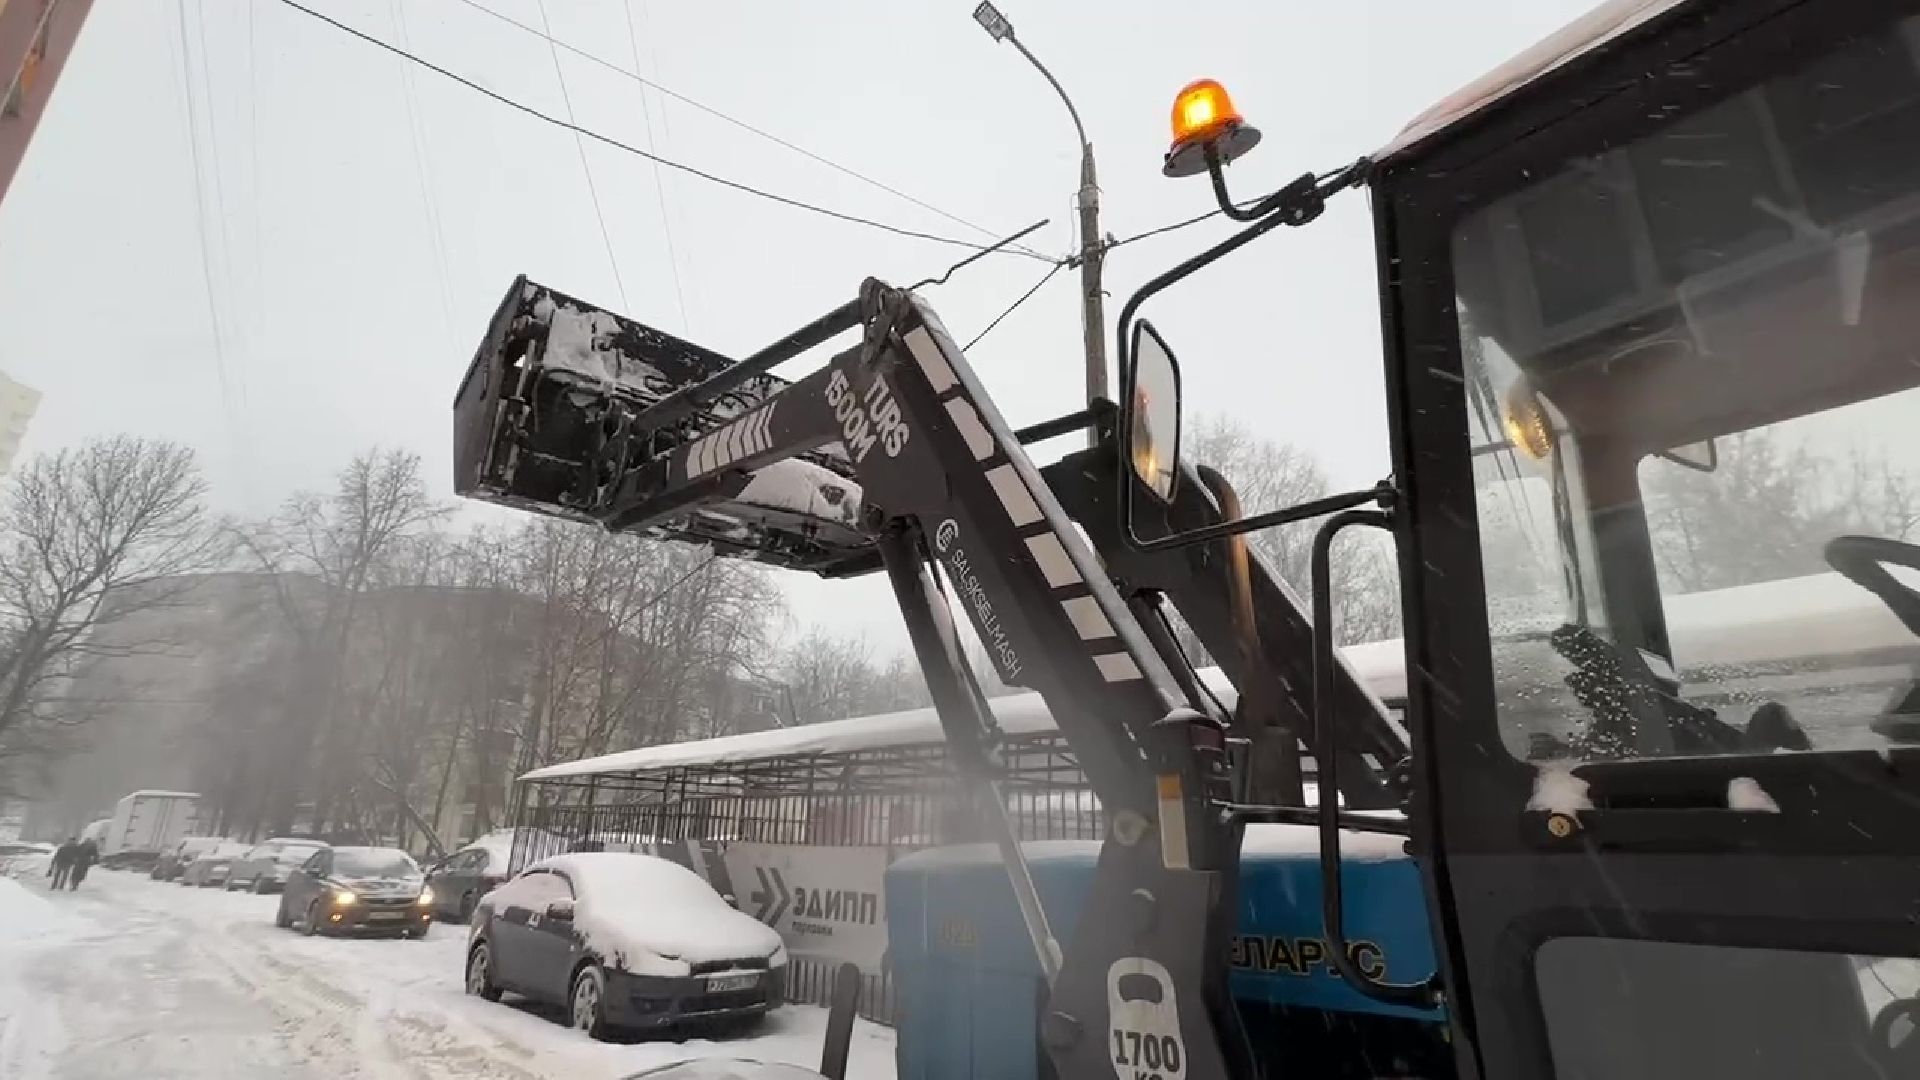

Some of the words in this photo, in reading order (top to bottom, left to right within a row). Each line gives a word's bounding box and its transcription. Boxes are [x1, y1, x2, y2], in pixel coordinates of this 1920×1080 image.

[825, 369, 877, 463] 1500M
[863, 371, 910, 458] TURS
[952, 549, 1024, 679] SALSKSELMASH
[1113, 1029, 1181, 1073] 1700
